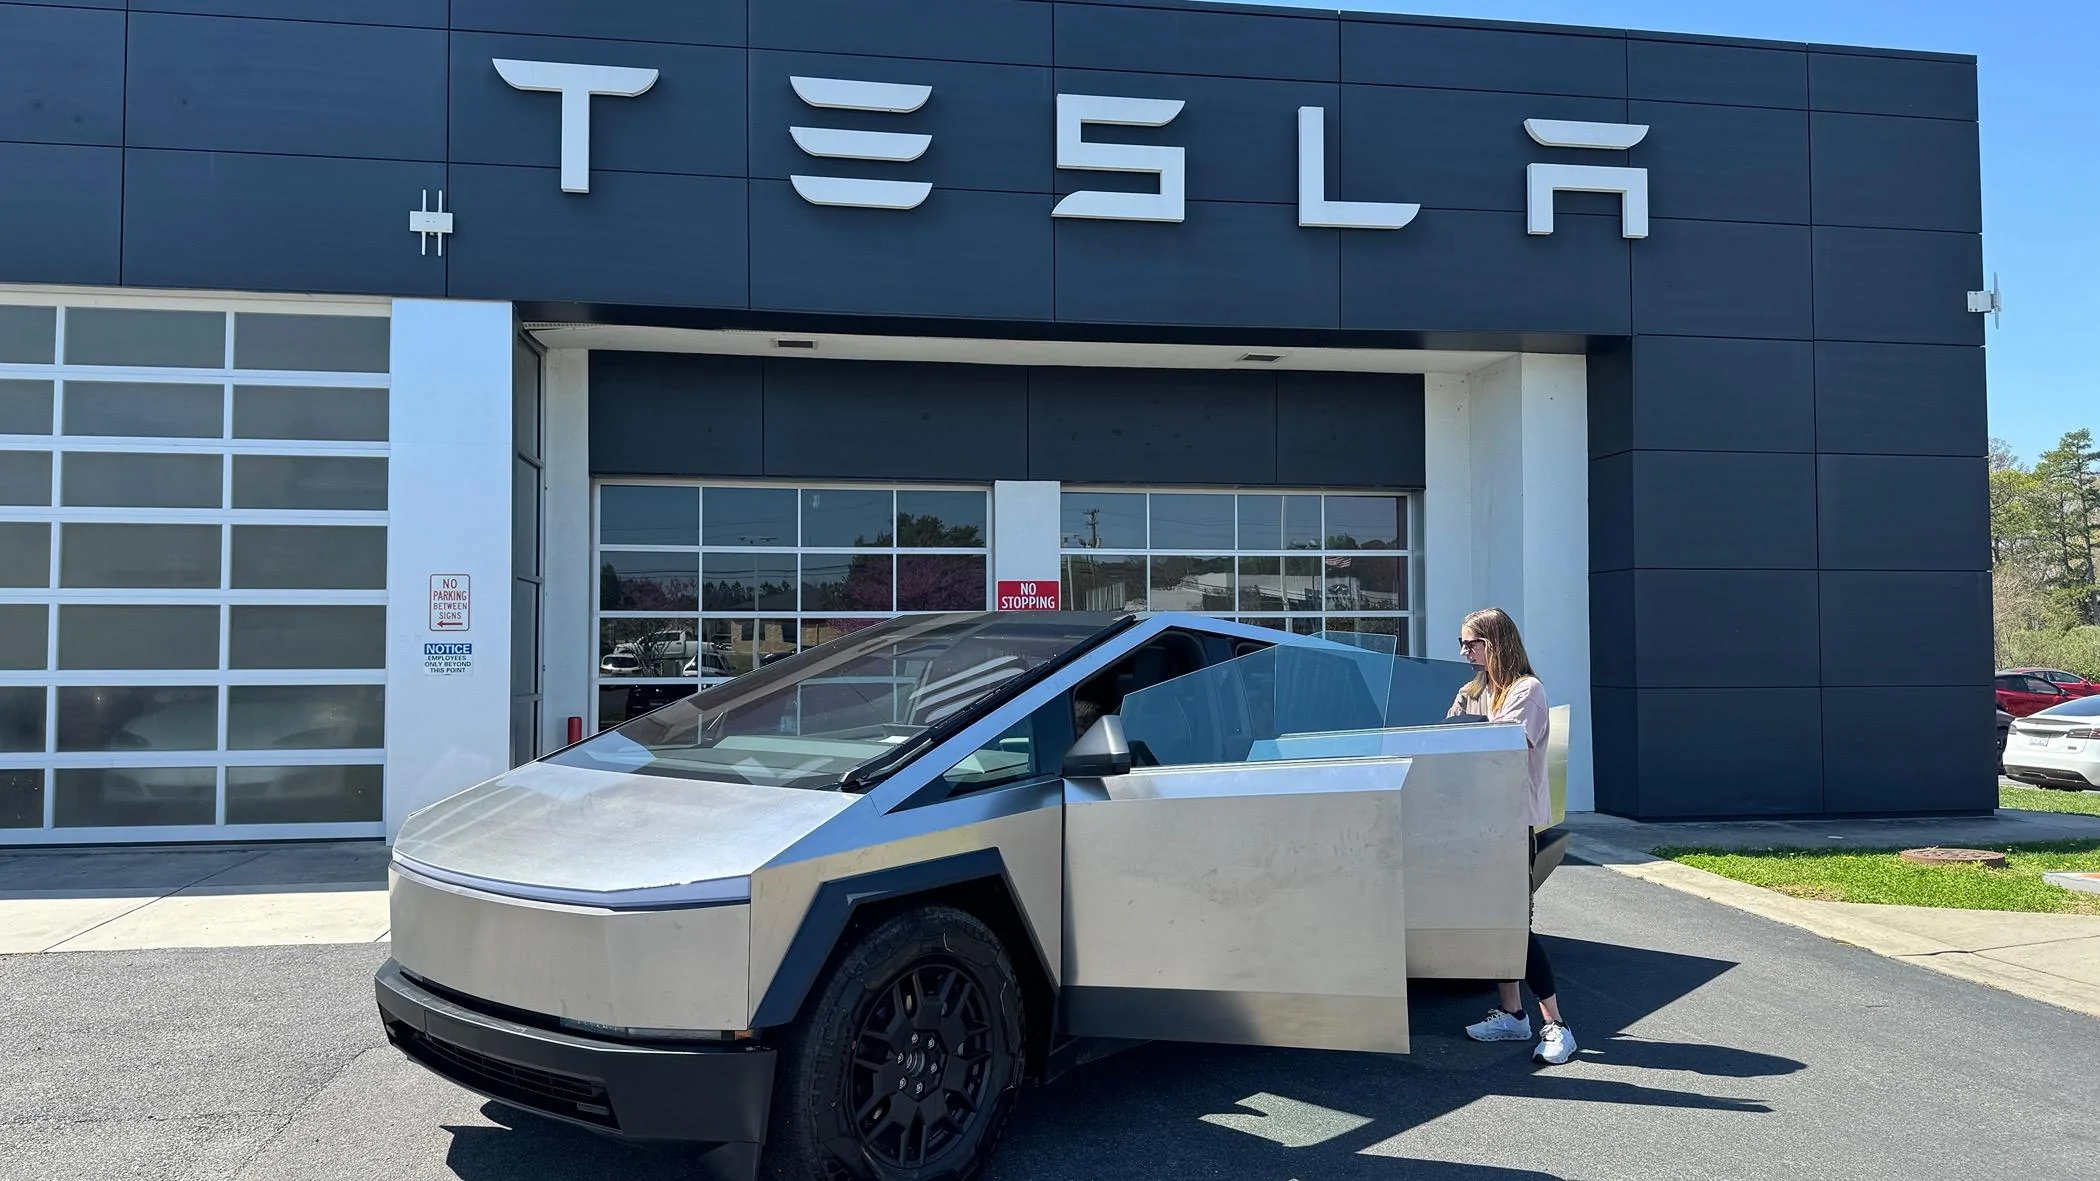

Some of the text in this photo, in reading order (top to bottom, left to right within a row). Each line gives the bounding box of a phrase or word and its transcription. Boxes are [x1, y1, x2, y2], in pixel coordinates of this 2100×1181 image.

[492, 58, 1650, 240] TESLA
[442, 578, 458, 589] NO
[1020, 582, 1037, 596] NO
[433, 590, 467, 601] PARKING
[433, 602, 468, 610] BETWEEN
[1001, 596, 1055, 609] STOPPING
[438, 611, 462, 620] SIGNS
[426, 644, 471, 654] NOTICE
